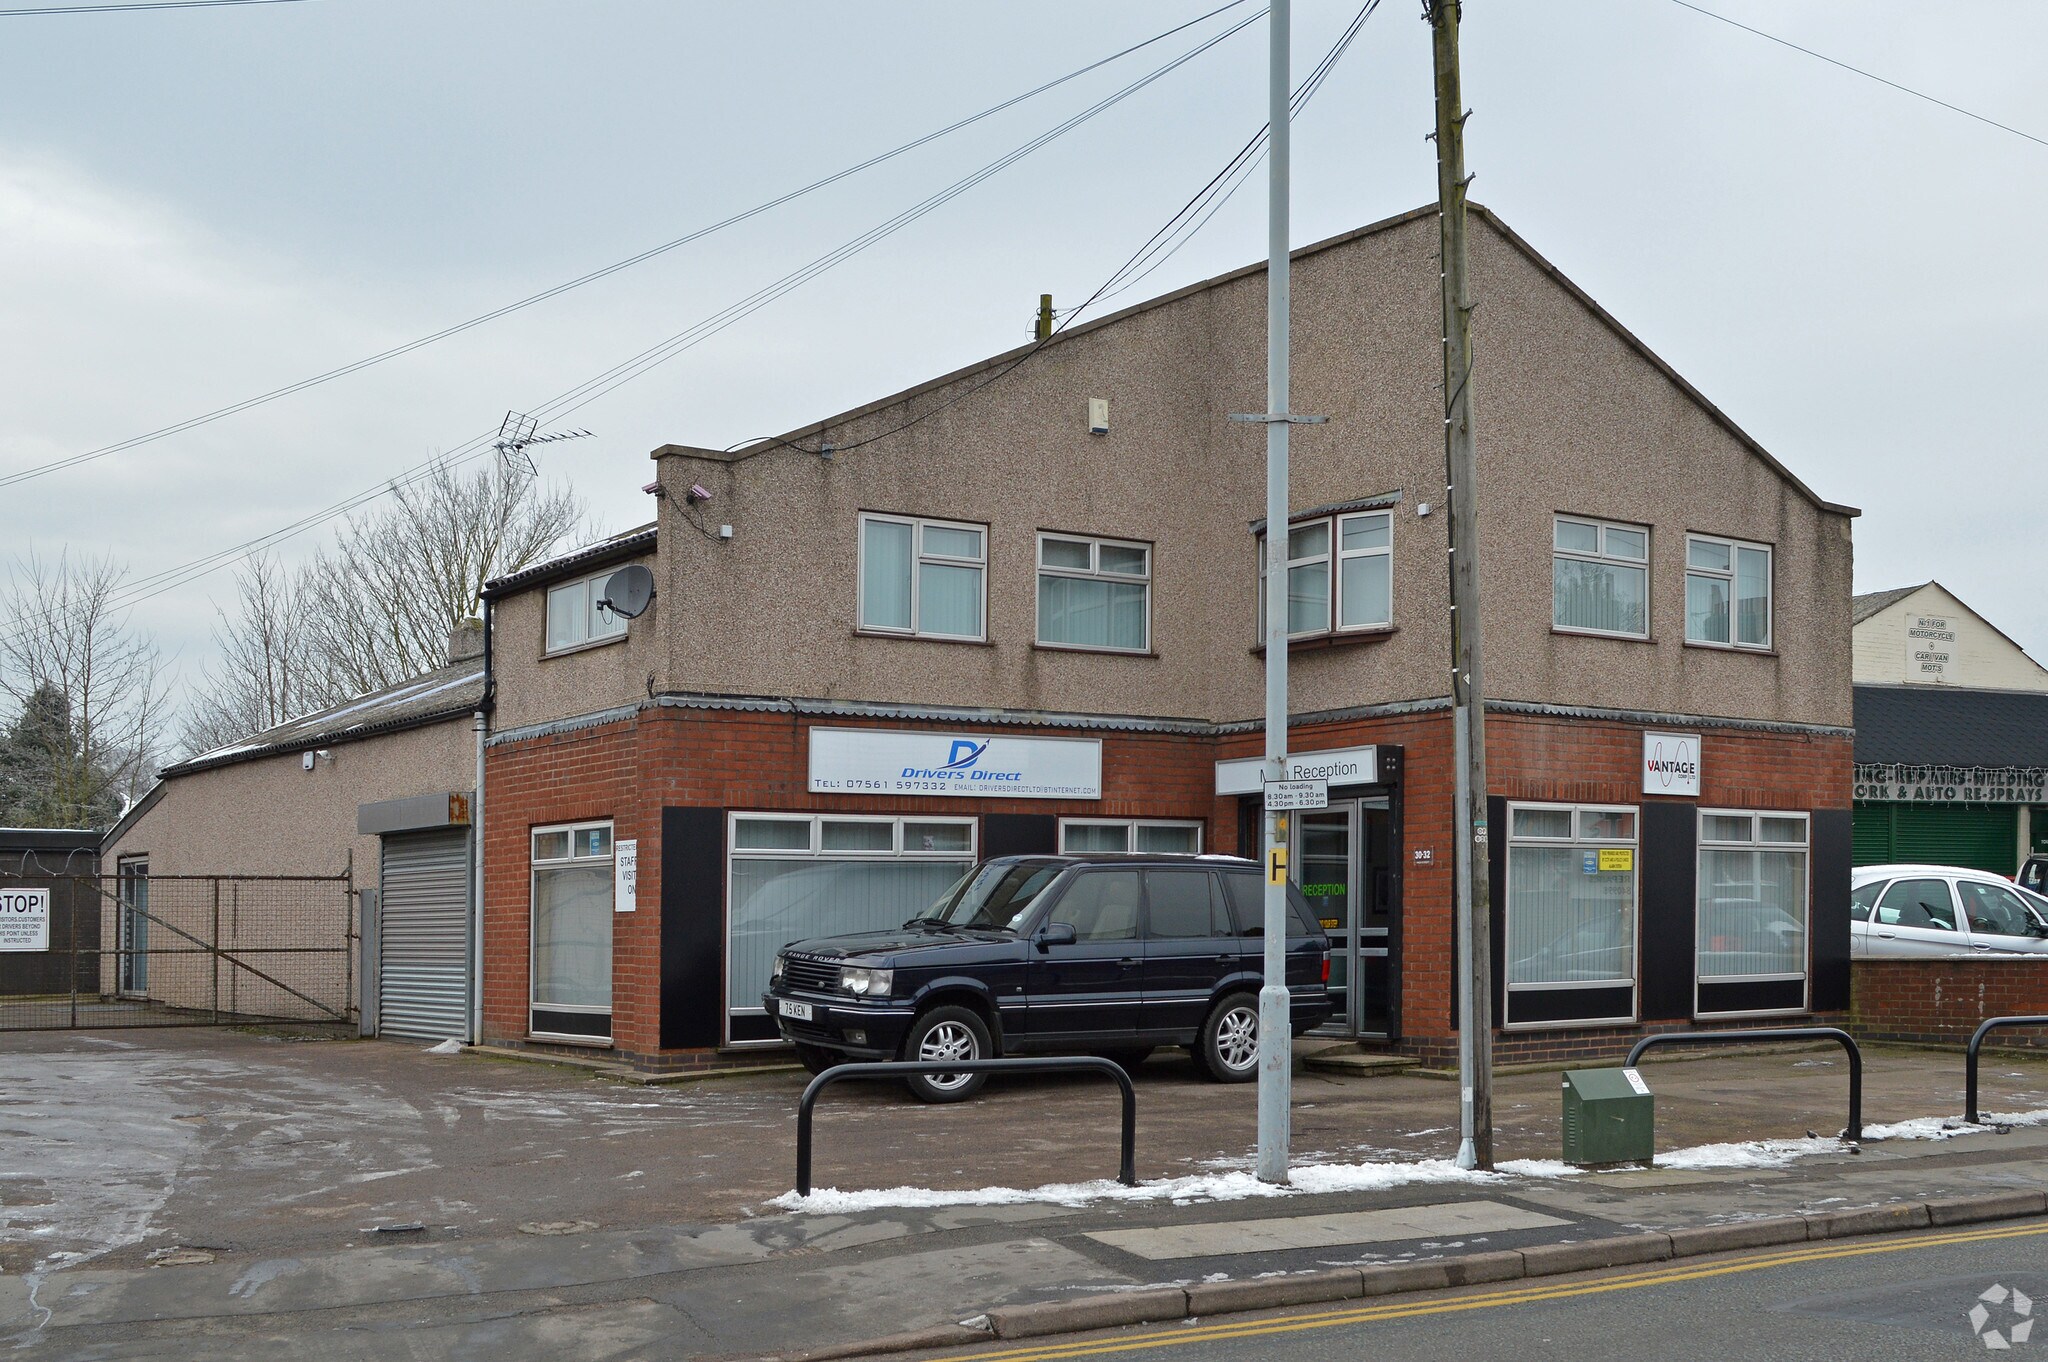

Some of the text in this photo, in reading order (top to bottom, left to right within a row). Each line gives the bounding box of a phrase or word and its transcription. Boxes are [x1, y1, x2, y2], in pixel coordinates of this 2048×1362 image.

[1910, 629, 1954, 641] MOTORCYCLE
[1293, 762, 1358, 781] Reception
[1647, 759, 1695, 774] VANTAGE
[901, 767, 1023, 781] Drivers Direct
[846, 779, 889, 789] 07561
[896, 781, 946, 791] 597332
[1896, 785, 1907, 799] &
[1913, 786, 1956, 800] AUTO
[1964, 787, 2042, 801] RE-SPRAYS
[1303, 883, 1346, 896] RECEPTION
[0, 895, 44, 913] TOP!
[787, 951, 840, 963] RANGE ROVER
[794, 1003, 806, 1018] KEN
